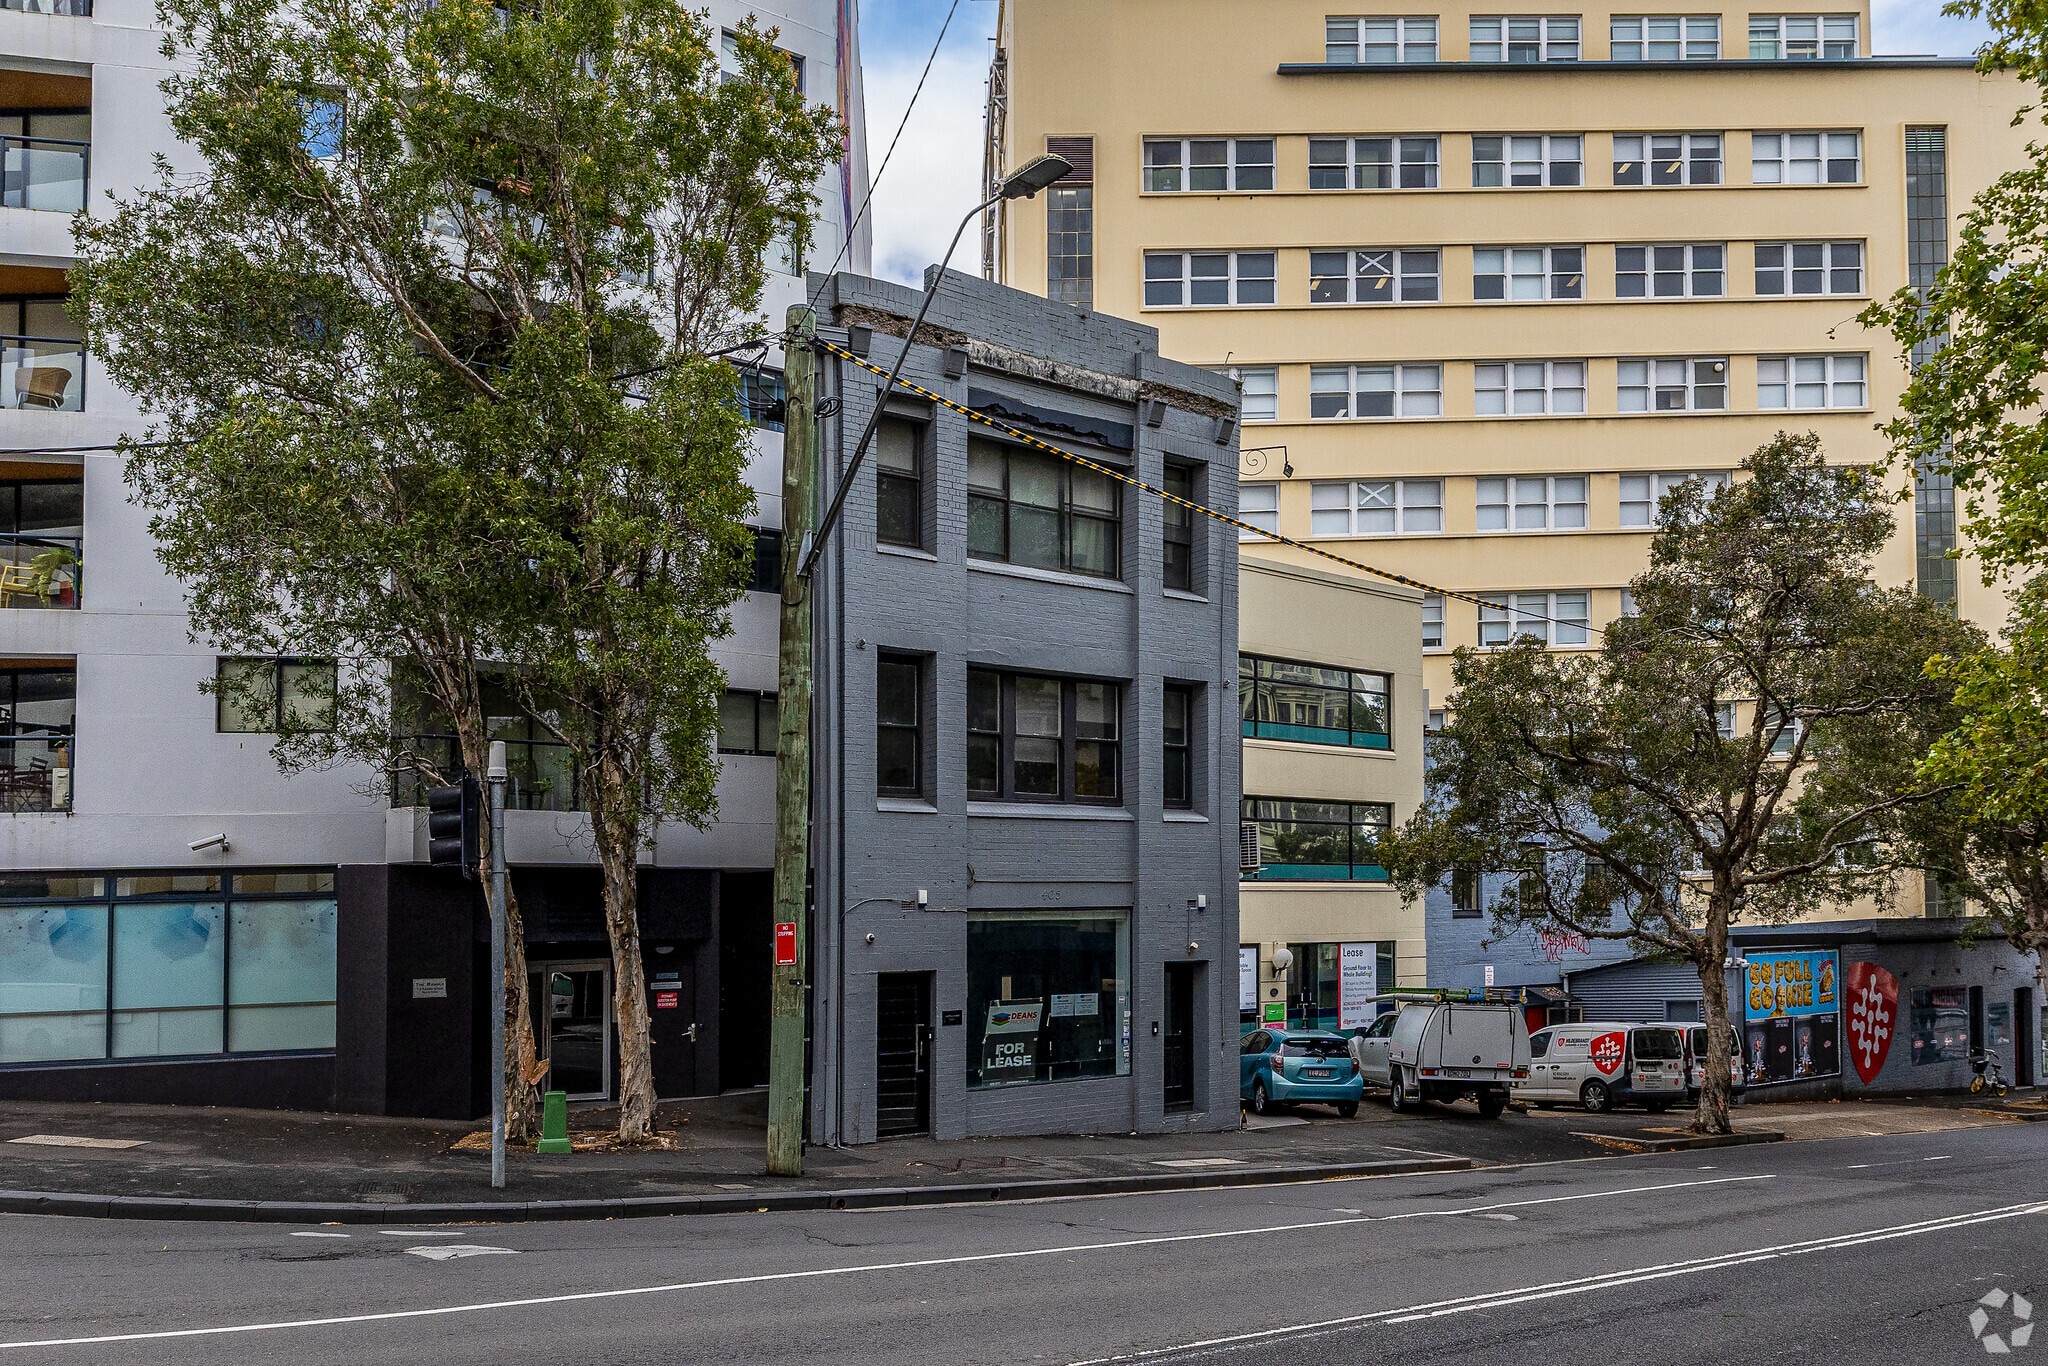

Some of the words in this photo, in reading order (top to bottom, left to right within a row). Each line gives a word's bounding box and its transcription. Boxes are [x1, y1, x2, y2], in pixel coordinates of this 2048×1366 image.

[1041, 889, 1061, 901] 405
[1343, 948, 1363, 957] Lease
[1749, 962, 1773, 985] GO
[1774, 960, 1812, 983] FULL
[1011, 1011, 1038, 1020] DEANS
[995, 1042, 1025, 1055] FOR
[987, 1055, 1032, 1069] LEASE
